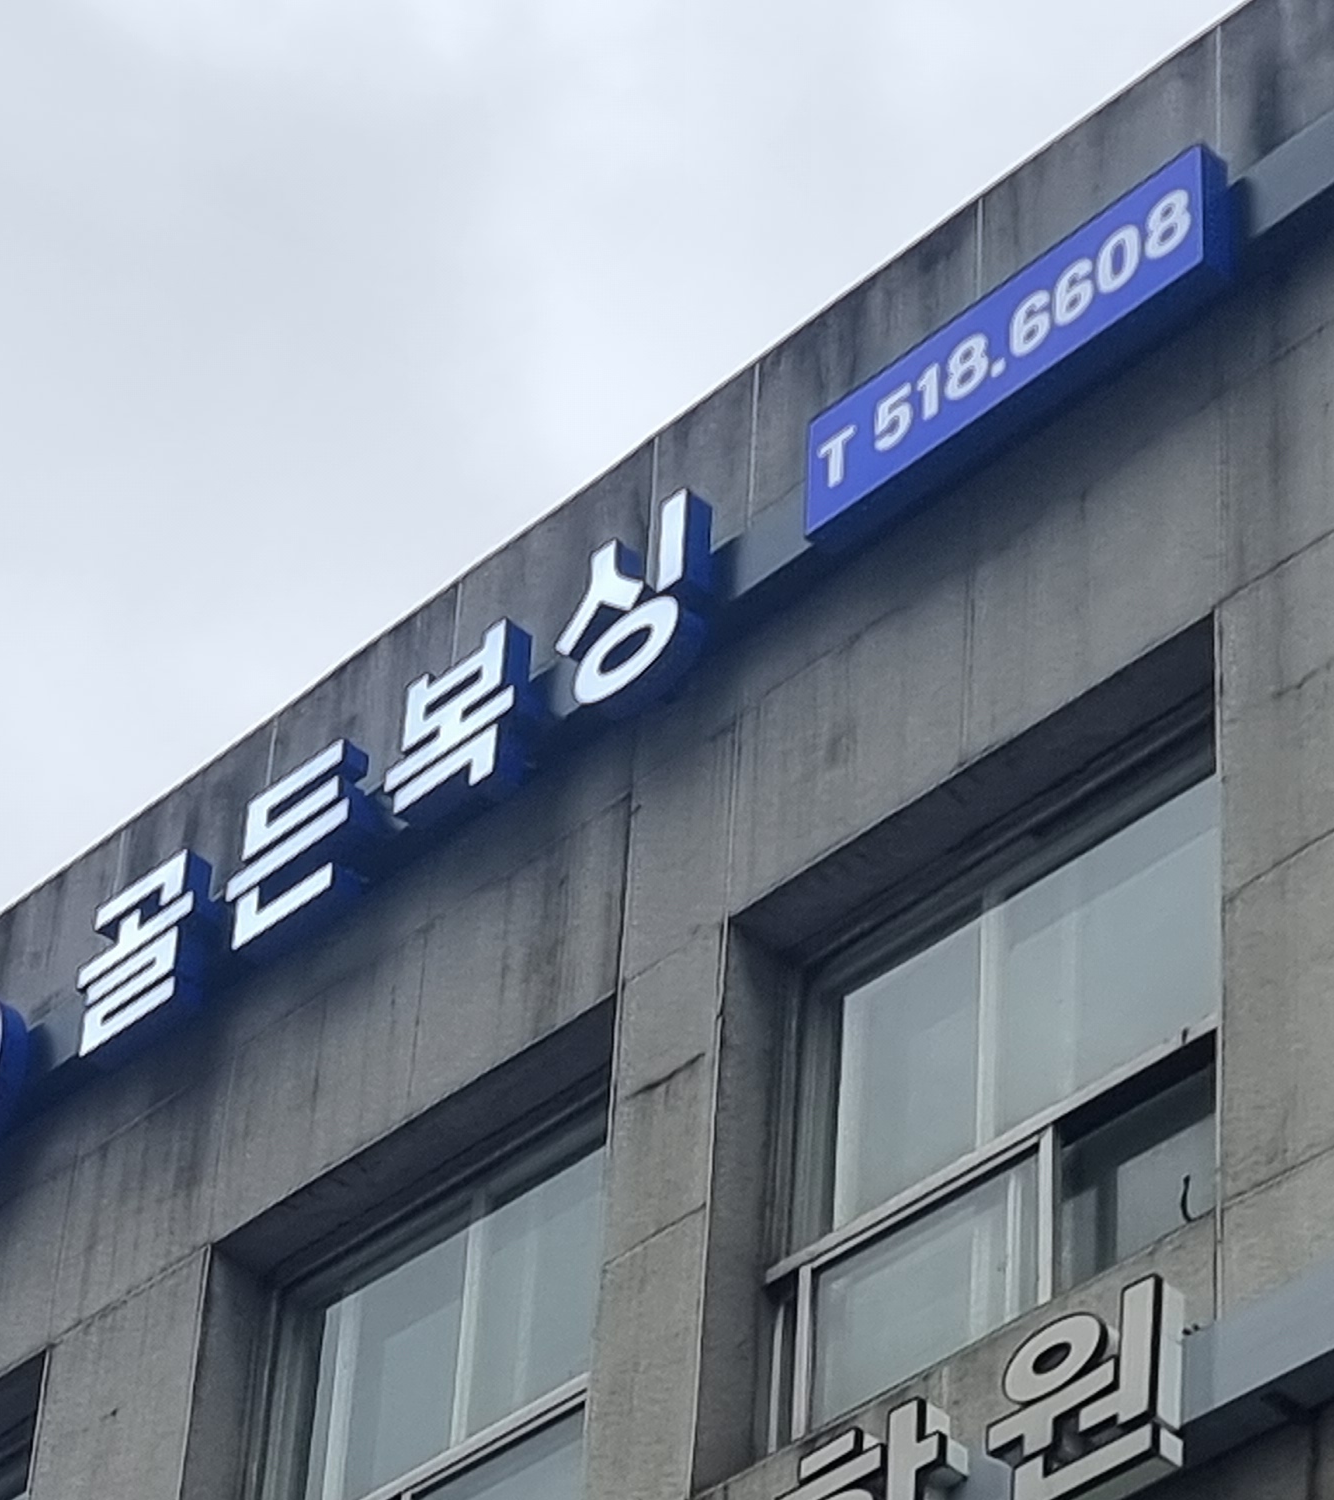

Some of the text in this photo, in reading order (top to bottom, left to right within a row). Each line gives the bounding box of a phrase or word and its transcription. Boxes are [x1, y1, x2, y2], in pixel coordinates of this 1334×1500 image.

[816, 188, 1193, 489] T 518.6608
[77, 488, 691, 1058] 골든복싱
